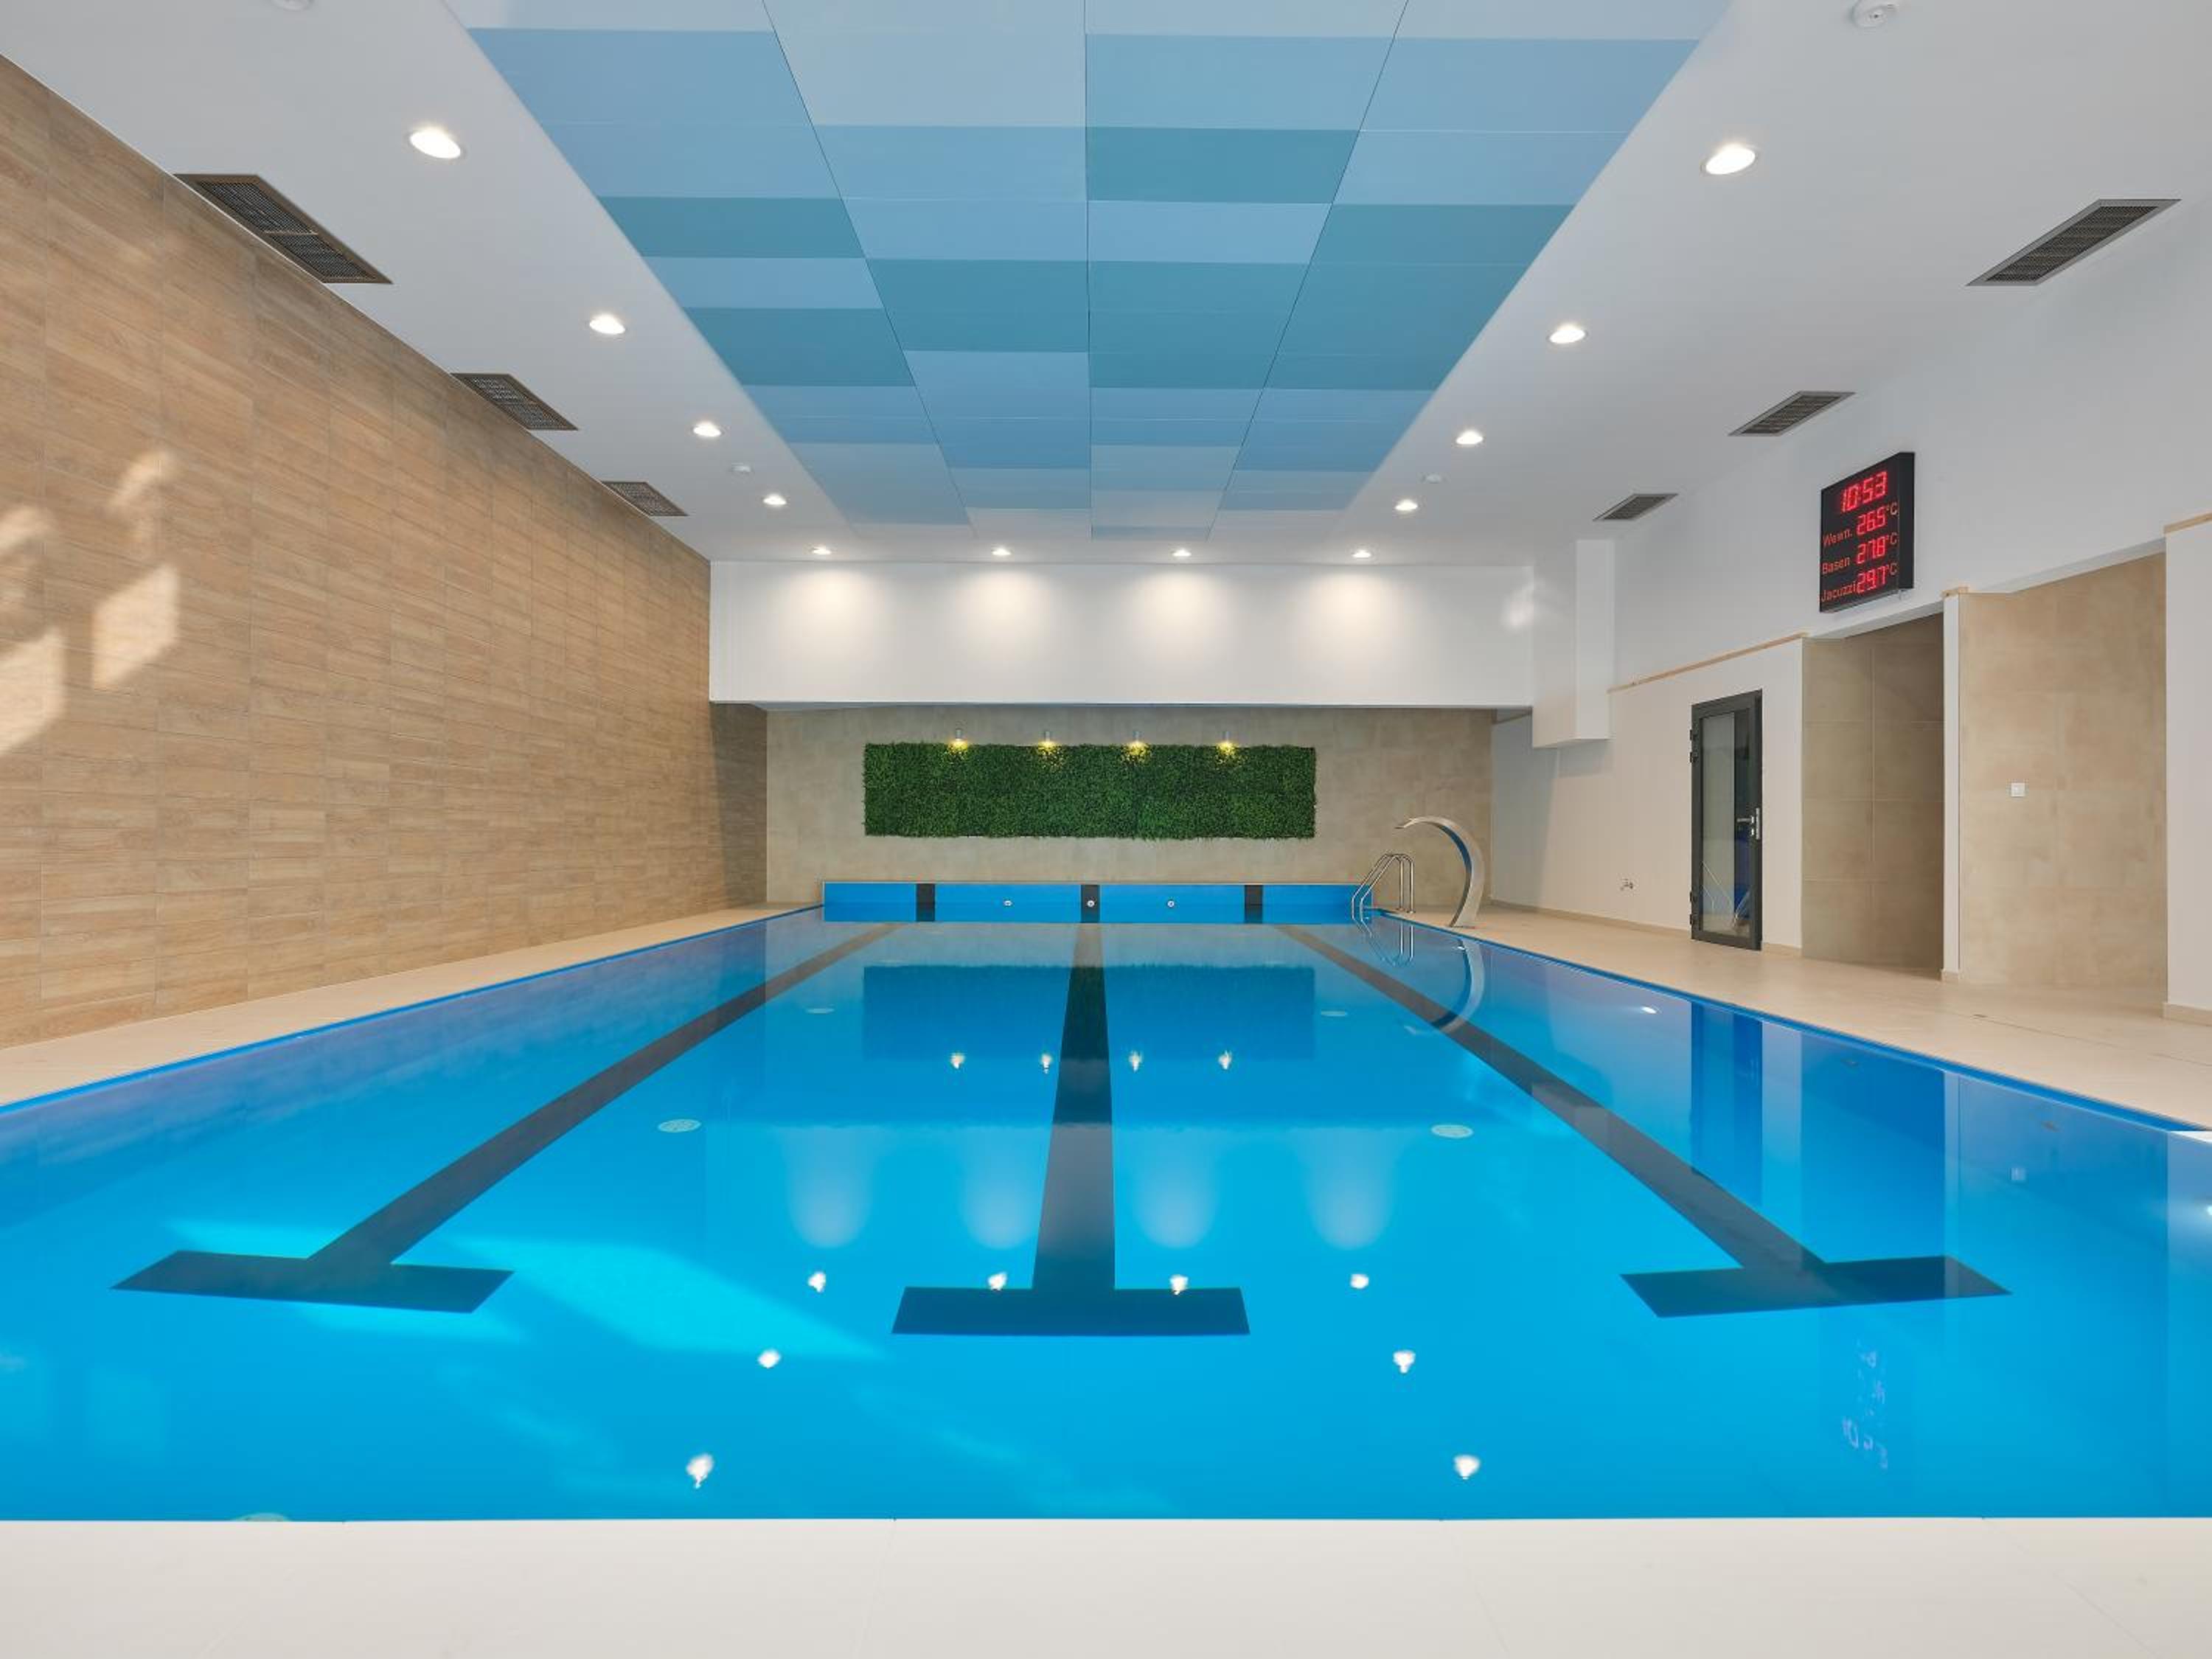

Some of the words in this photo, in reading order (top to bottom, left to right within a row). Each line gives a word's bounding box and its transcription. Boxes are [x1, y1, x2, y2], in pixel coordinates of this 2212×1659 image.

[1841, 470, 1888, 512] 10:53
[1822, 557, 1850, 574] Basen
[1821, 580, 1856, 602] Jacuzzi
